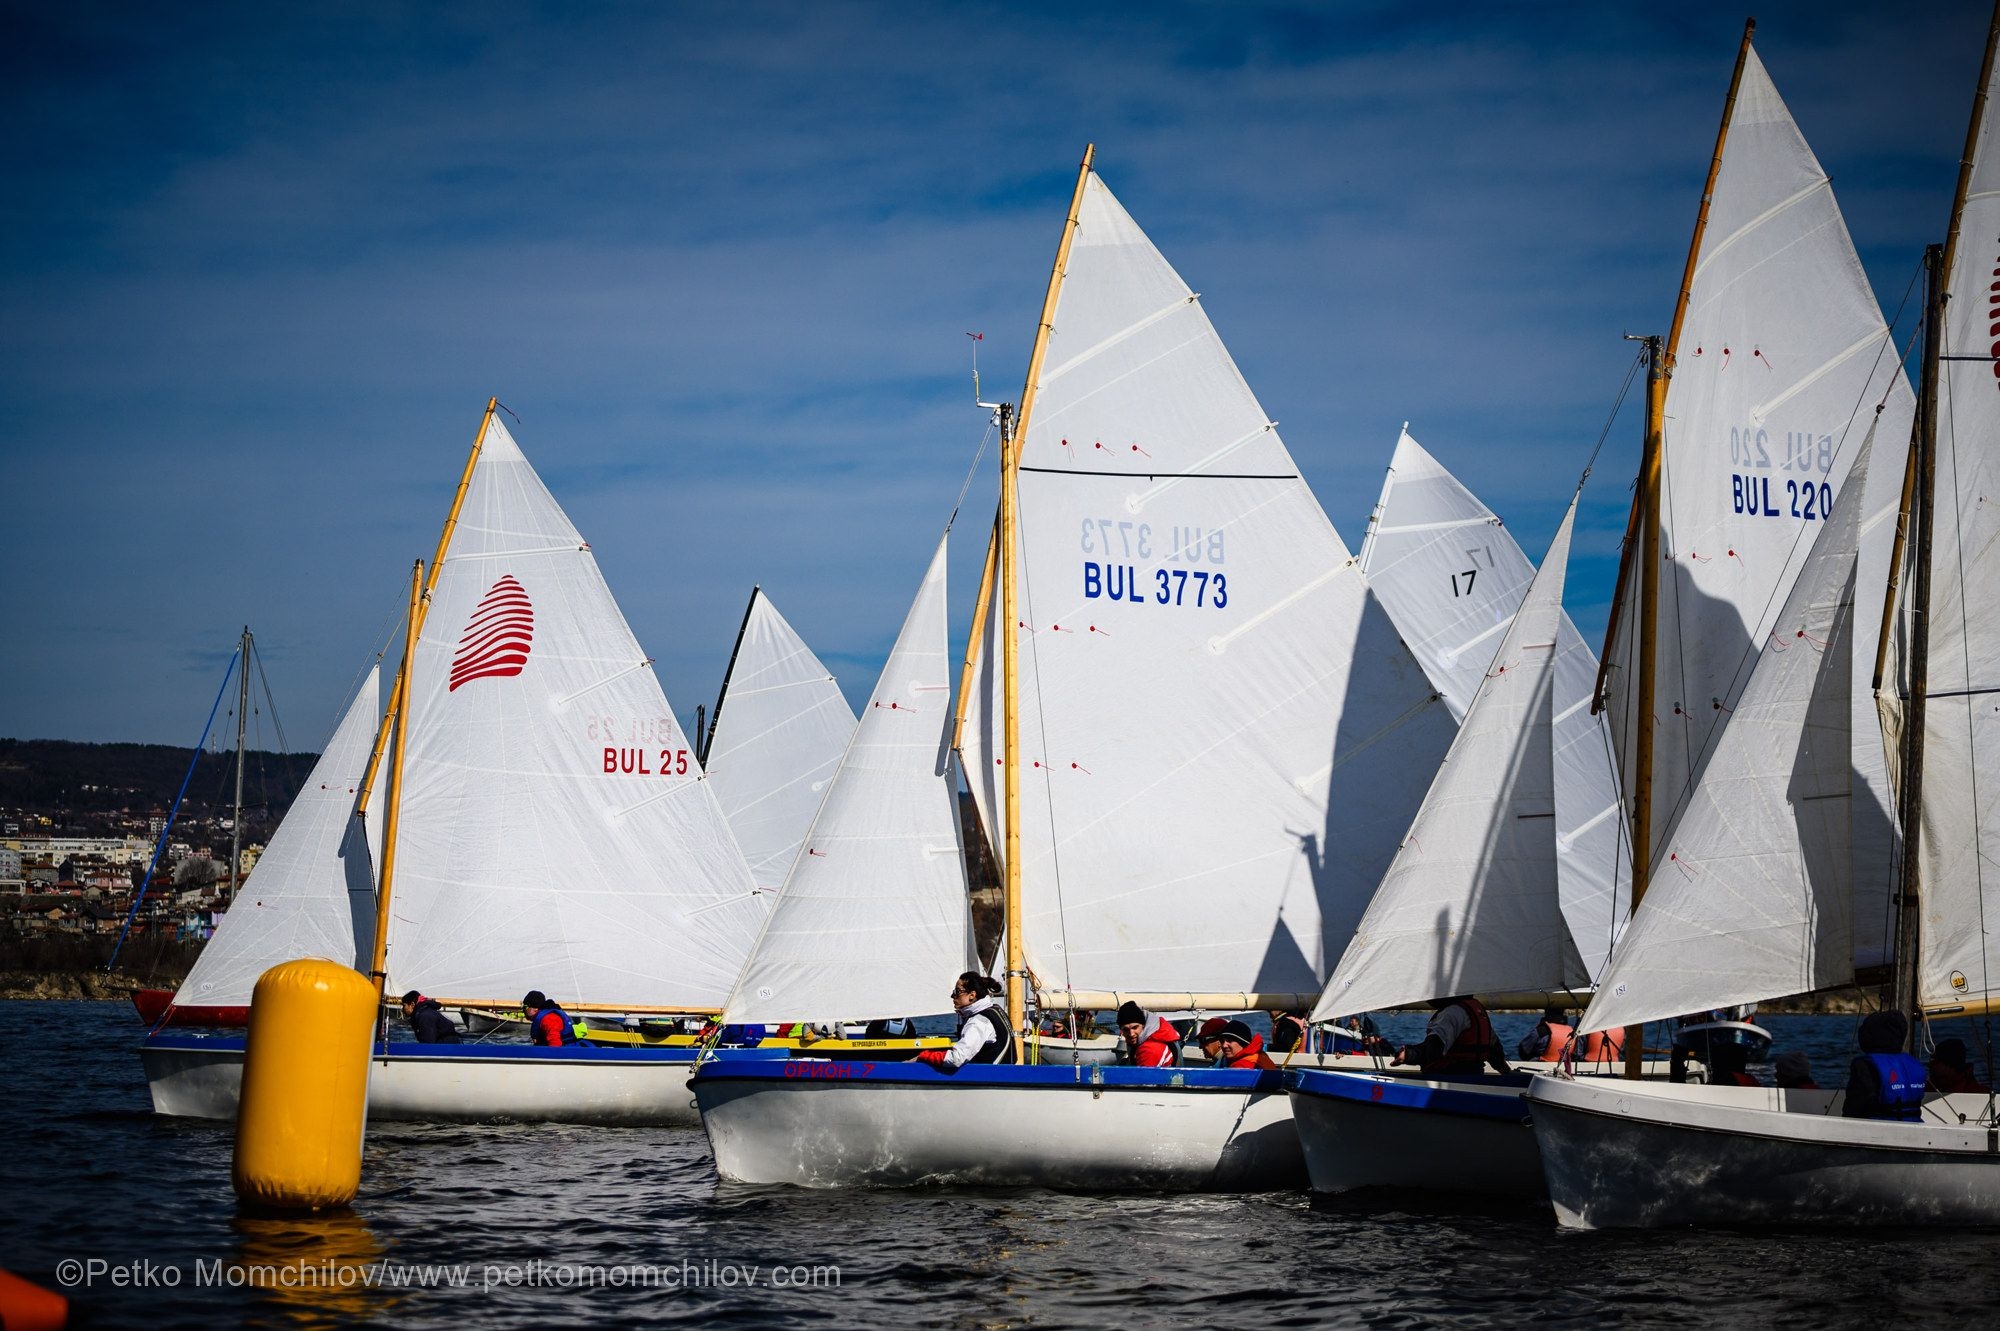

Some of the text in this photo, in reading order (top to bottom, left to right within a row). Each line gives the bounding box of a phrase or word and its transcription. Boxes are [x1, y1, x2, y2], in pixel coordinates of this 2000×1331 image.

[1732, 473, 1833, 521] BUL 220
[1084, 561, 1229, 609] BUL 3773
[1451, 569, 1477, 598] 17
[603, 747, 688, 775] BUL 25
[783, 1062, 876, 1080] ОРИОН-7
